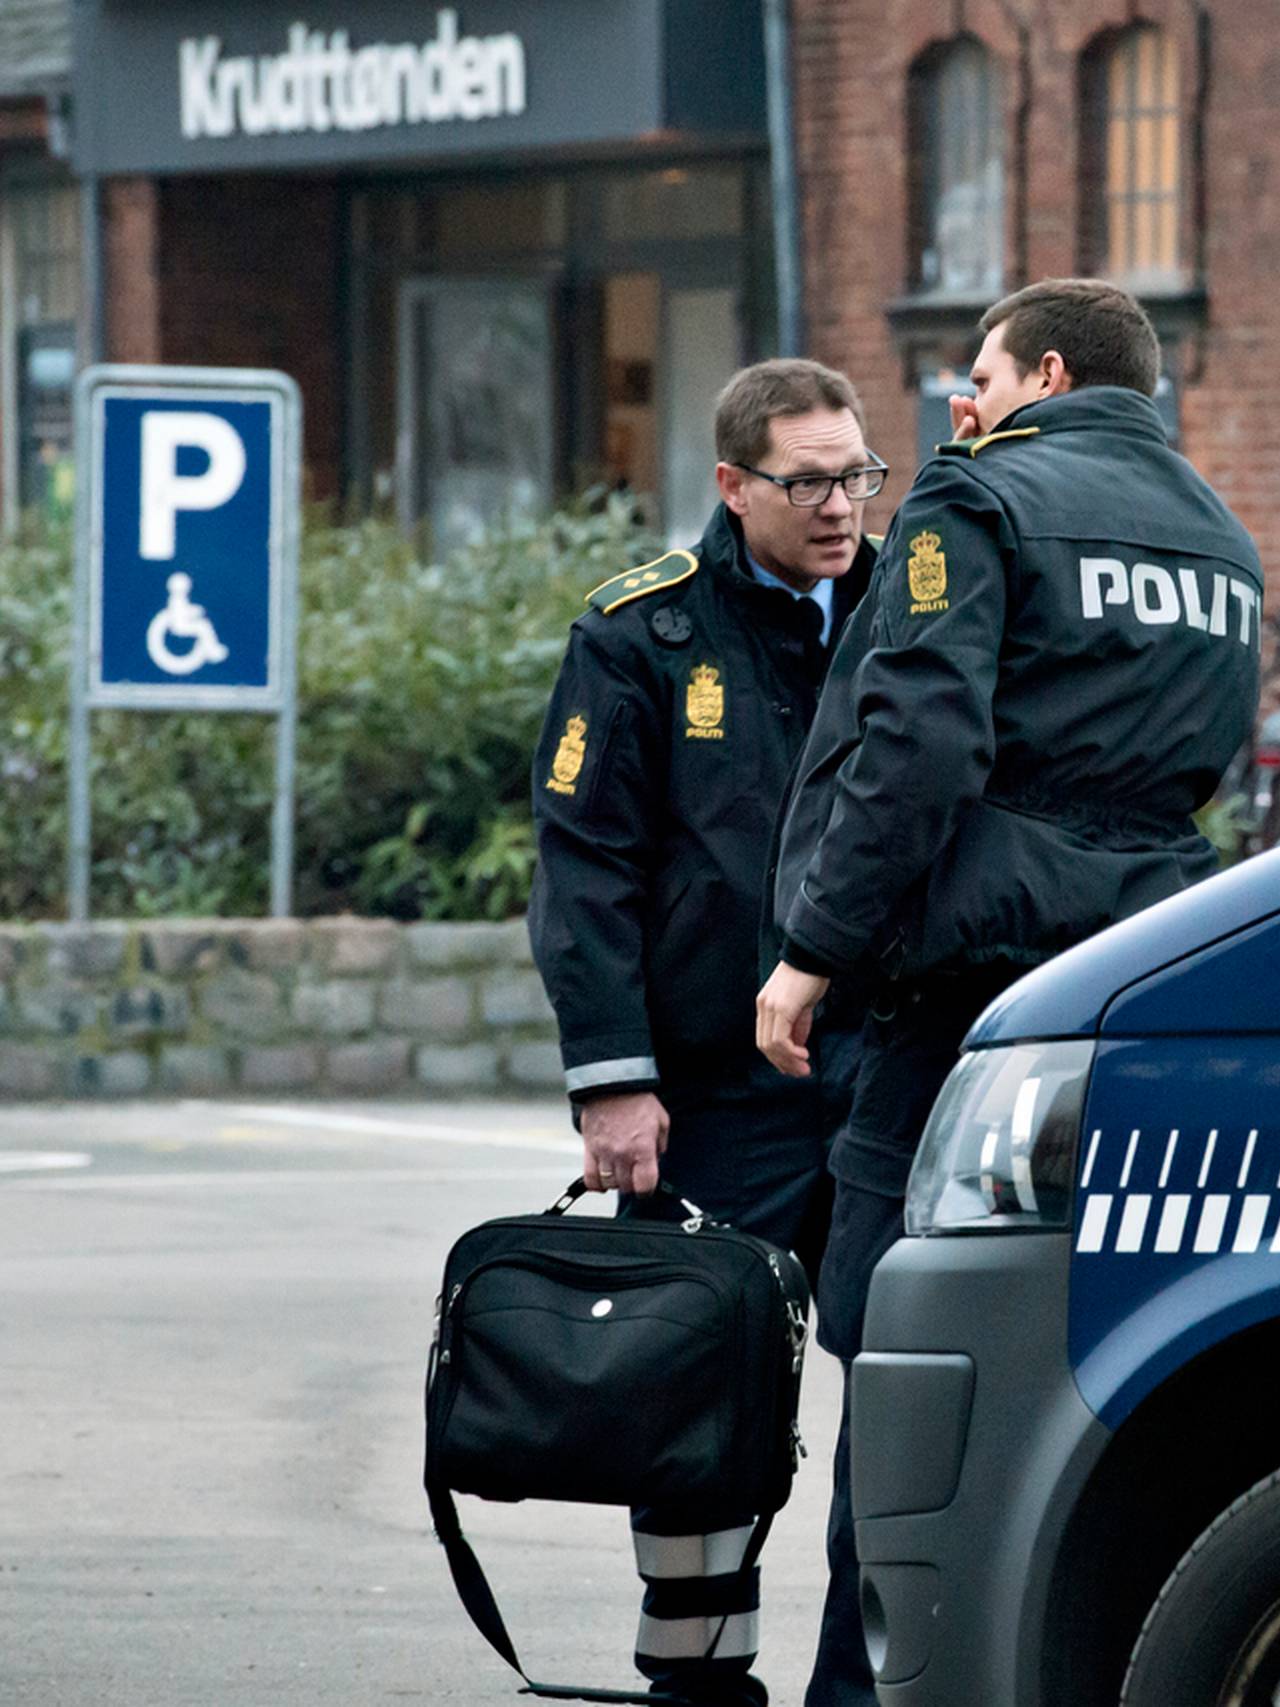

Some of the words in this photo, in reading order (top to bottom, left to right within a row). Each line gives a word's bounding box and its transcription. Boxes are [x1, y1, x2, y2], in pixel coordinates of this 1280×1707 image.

[180, 9, 526, 138] Krudttønden
[140, 411, 246, 560] P
[910, 599, 949, 615] POLITI
